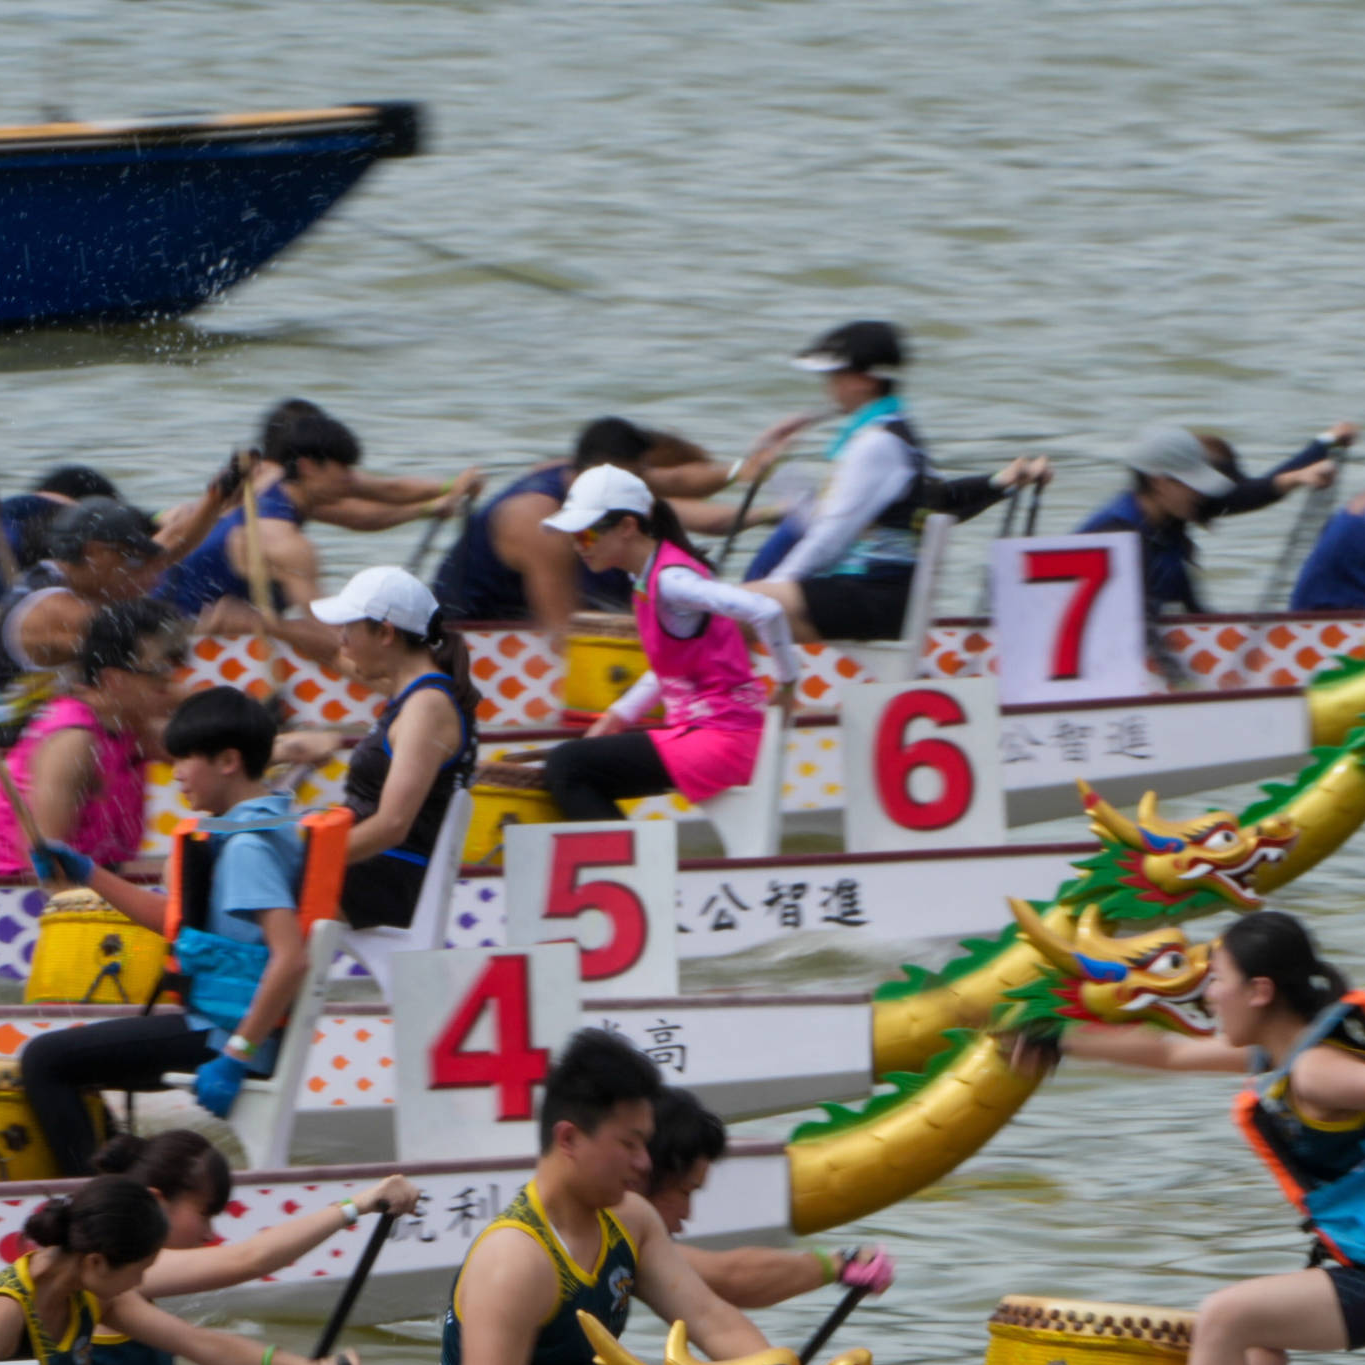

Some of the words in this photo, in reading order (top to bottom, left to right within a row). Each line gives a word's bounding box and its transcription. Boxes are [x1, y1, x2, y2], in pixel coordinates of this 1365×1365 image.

[1023, 547, 1112, 681] 7
[872, 688, 975, 832] 6
[542, 829, 648, 983] 5
[428, 953, 551, 1122] 4
